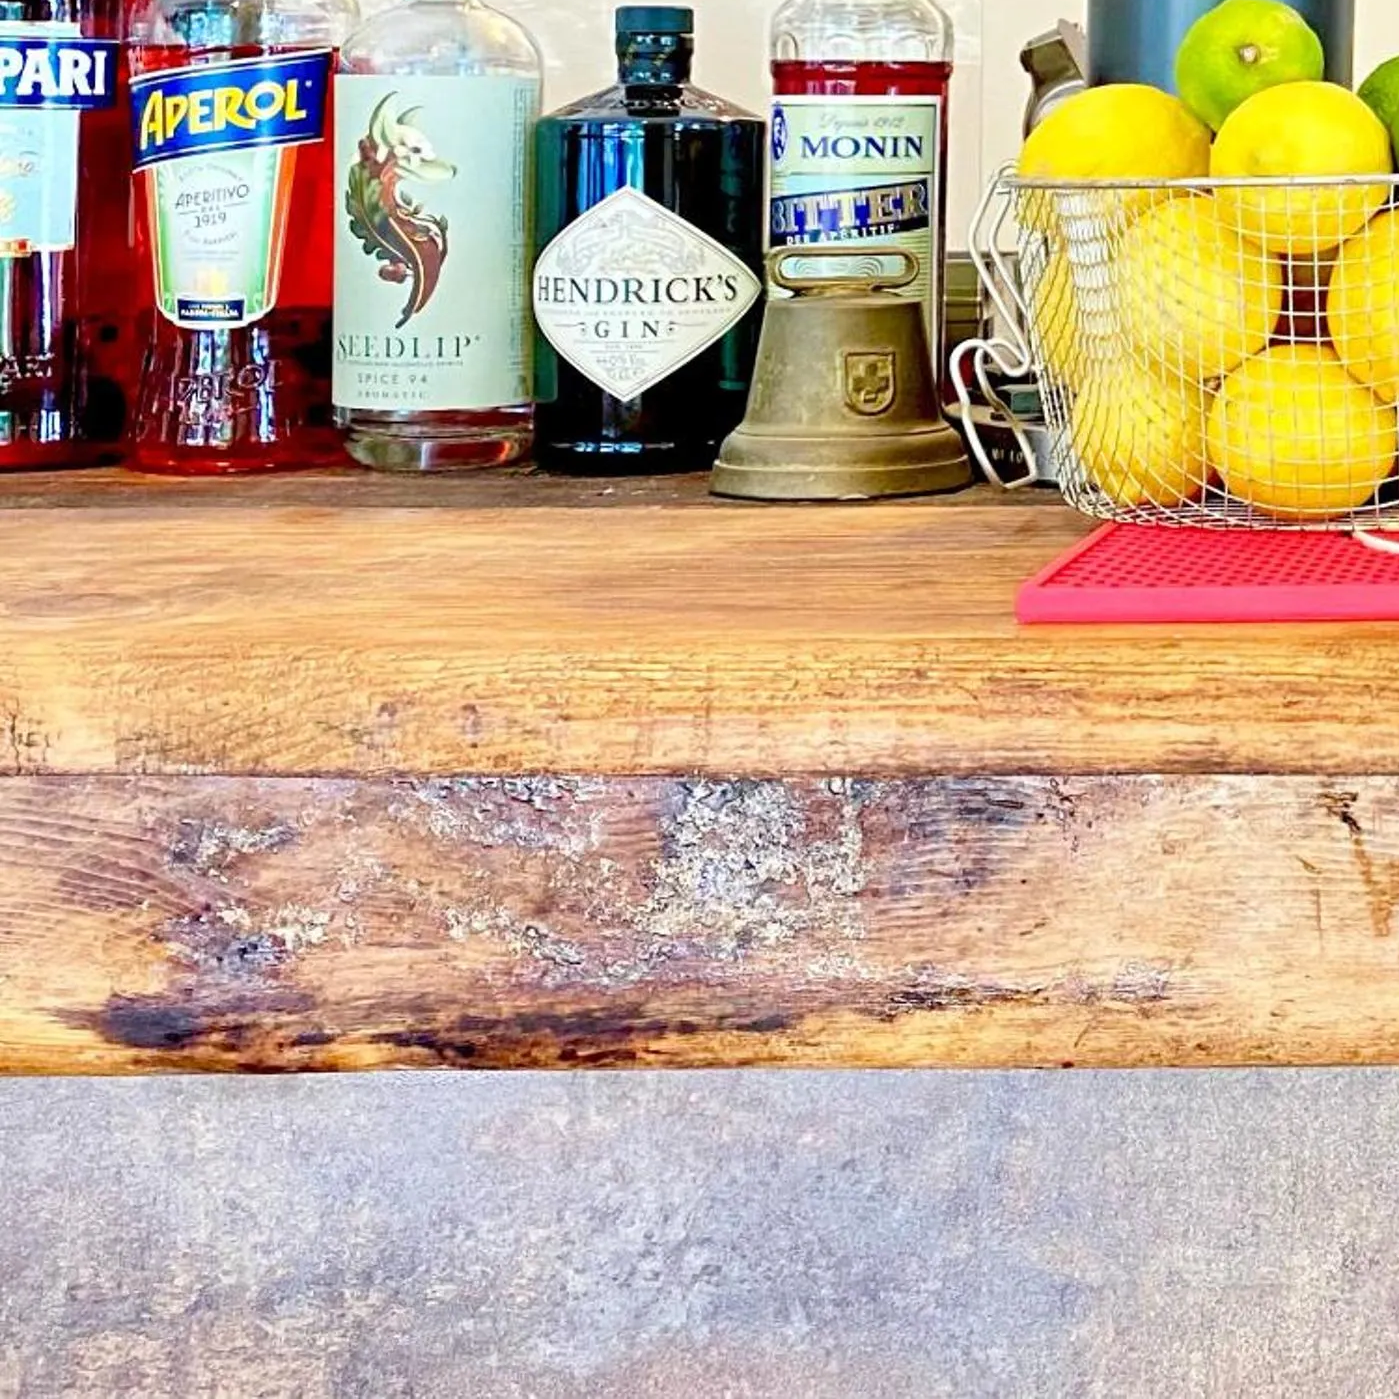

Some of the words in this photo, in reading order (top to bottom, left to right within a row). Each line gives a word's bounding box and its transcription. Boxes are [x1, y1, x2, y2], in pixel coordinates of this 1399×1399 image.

[139, 77, 307, 151] APEROL
[800, 135, 924, 159] MONIN
[175, 184, 250, 210] APERITIVO
[771, 184, 929, 233] BITTER
[194, 212, 227, 229] 1919
[537, 275, 738, 304] HENDRICK'S
[594, 320, 660, 339] GIN
[337, 333, 472, 364] SEEDLIP
